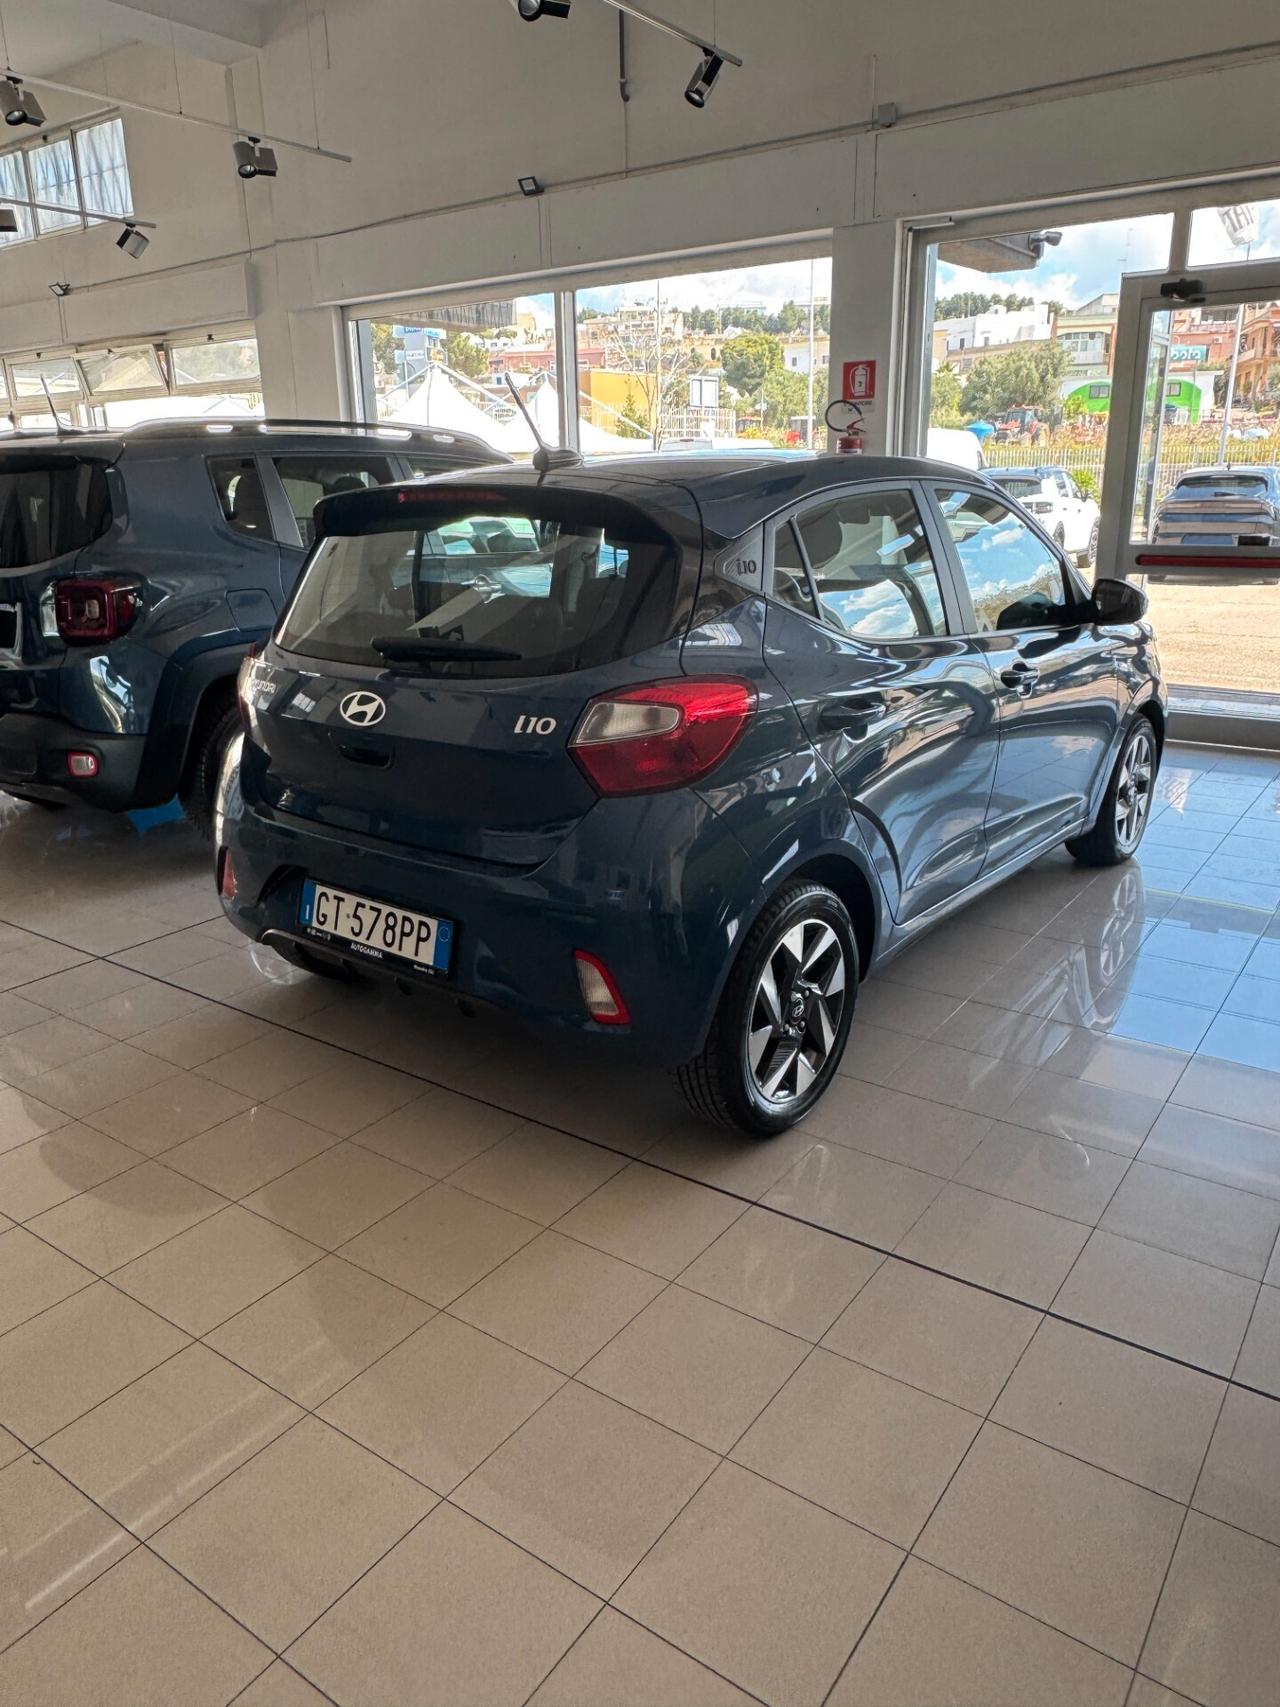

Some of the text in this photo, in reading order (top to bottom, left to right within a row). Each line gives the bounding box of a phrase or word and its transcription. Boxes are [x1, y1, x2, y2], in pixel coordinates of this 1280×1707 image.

[1170, 347, 1201, 360] bota
[736, 557, 757, 576] i10
[513, 715, 557, 735] i10
